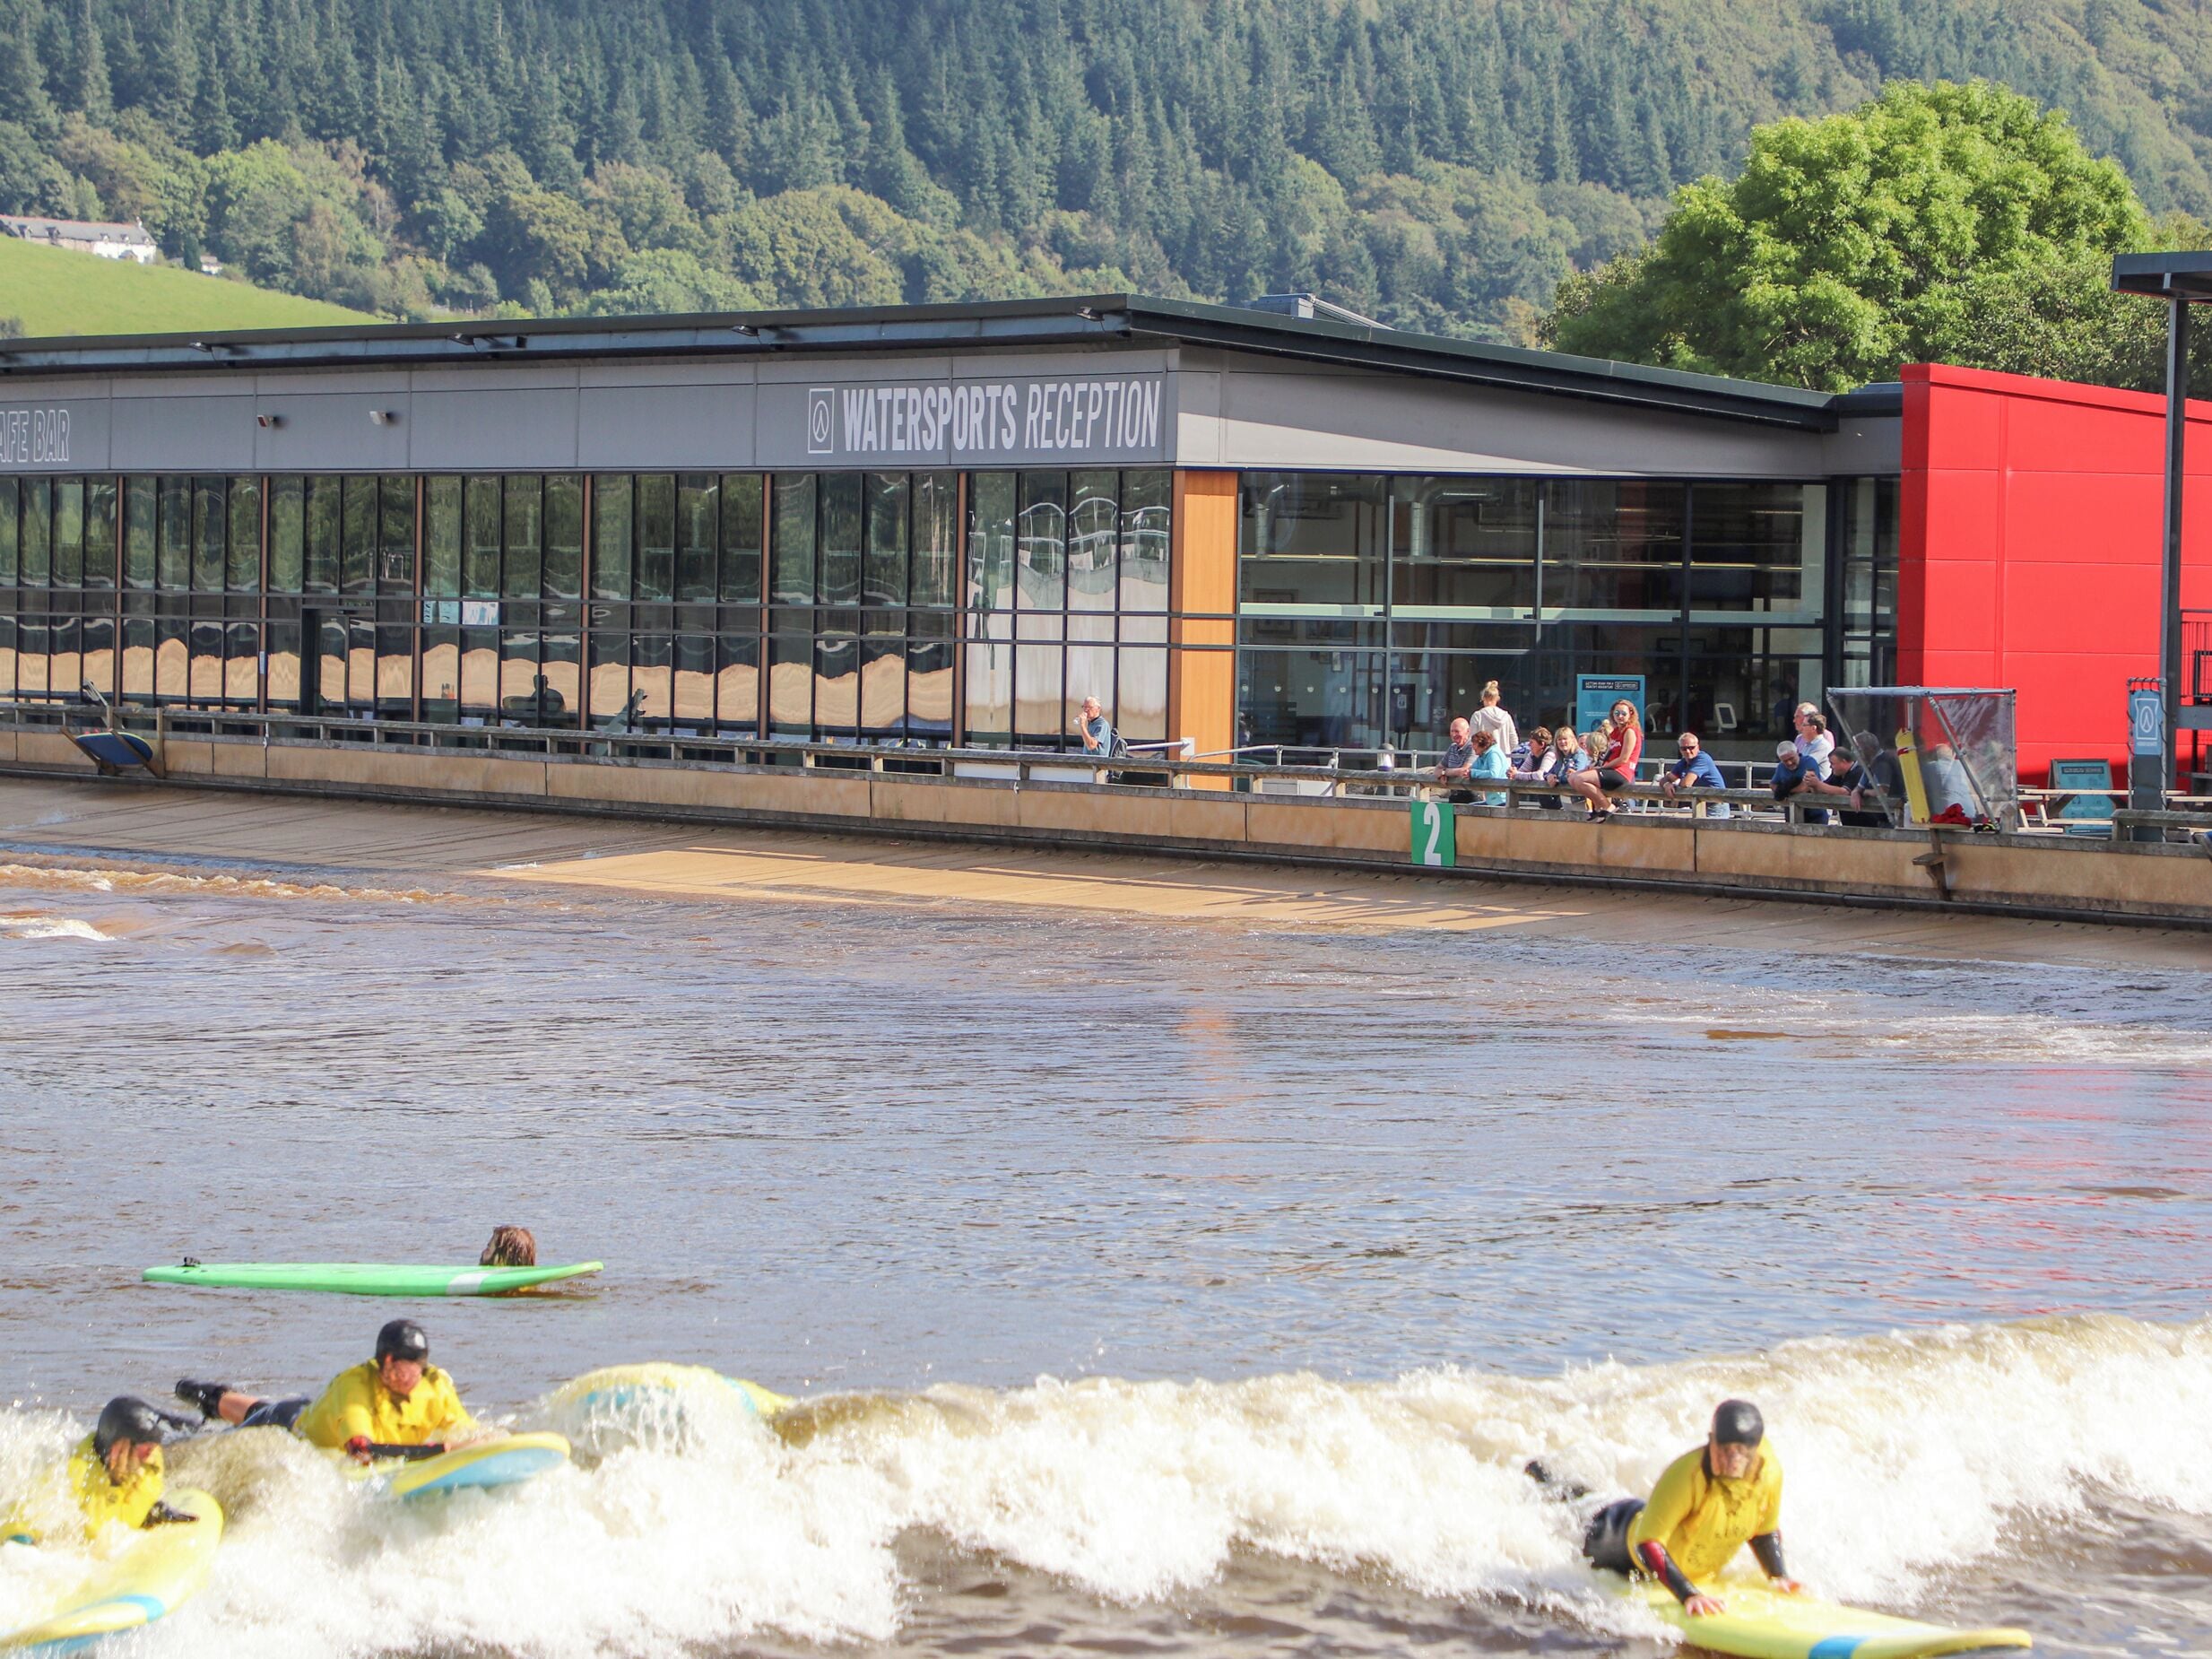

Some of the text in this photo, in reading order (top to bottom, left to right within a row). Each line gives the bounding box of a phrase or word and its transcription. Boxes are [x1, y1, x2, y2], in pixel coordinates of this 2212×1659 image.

[33, 409, 70, 462] BAR
[843, 380, 1161, 451] WATERSPORTS RECEPTION
[1424, 802, 1442, 866] 2
